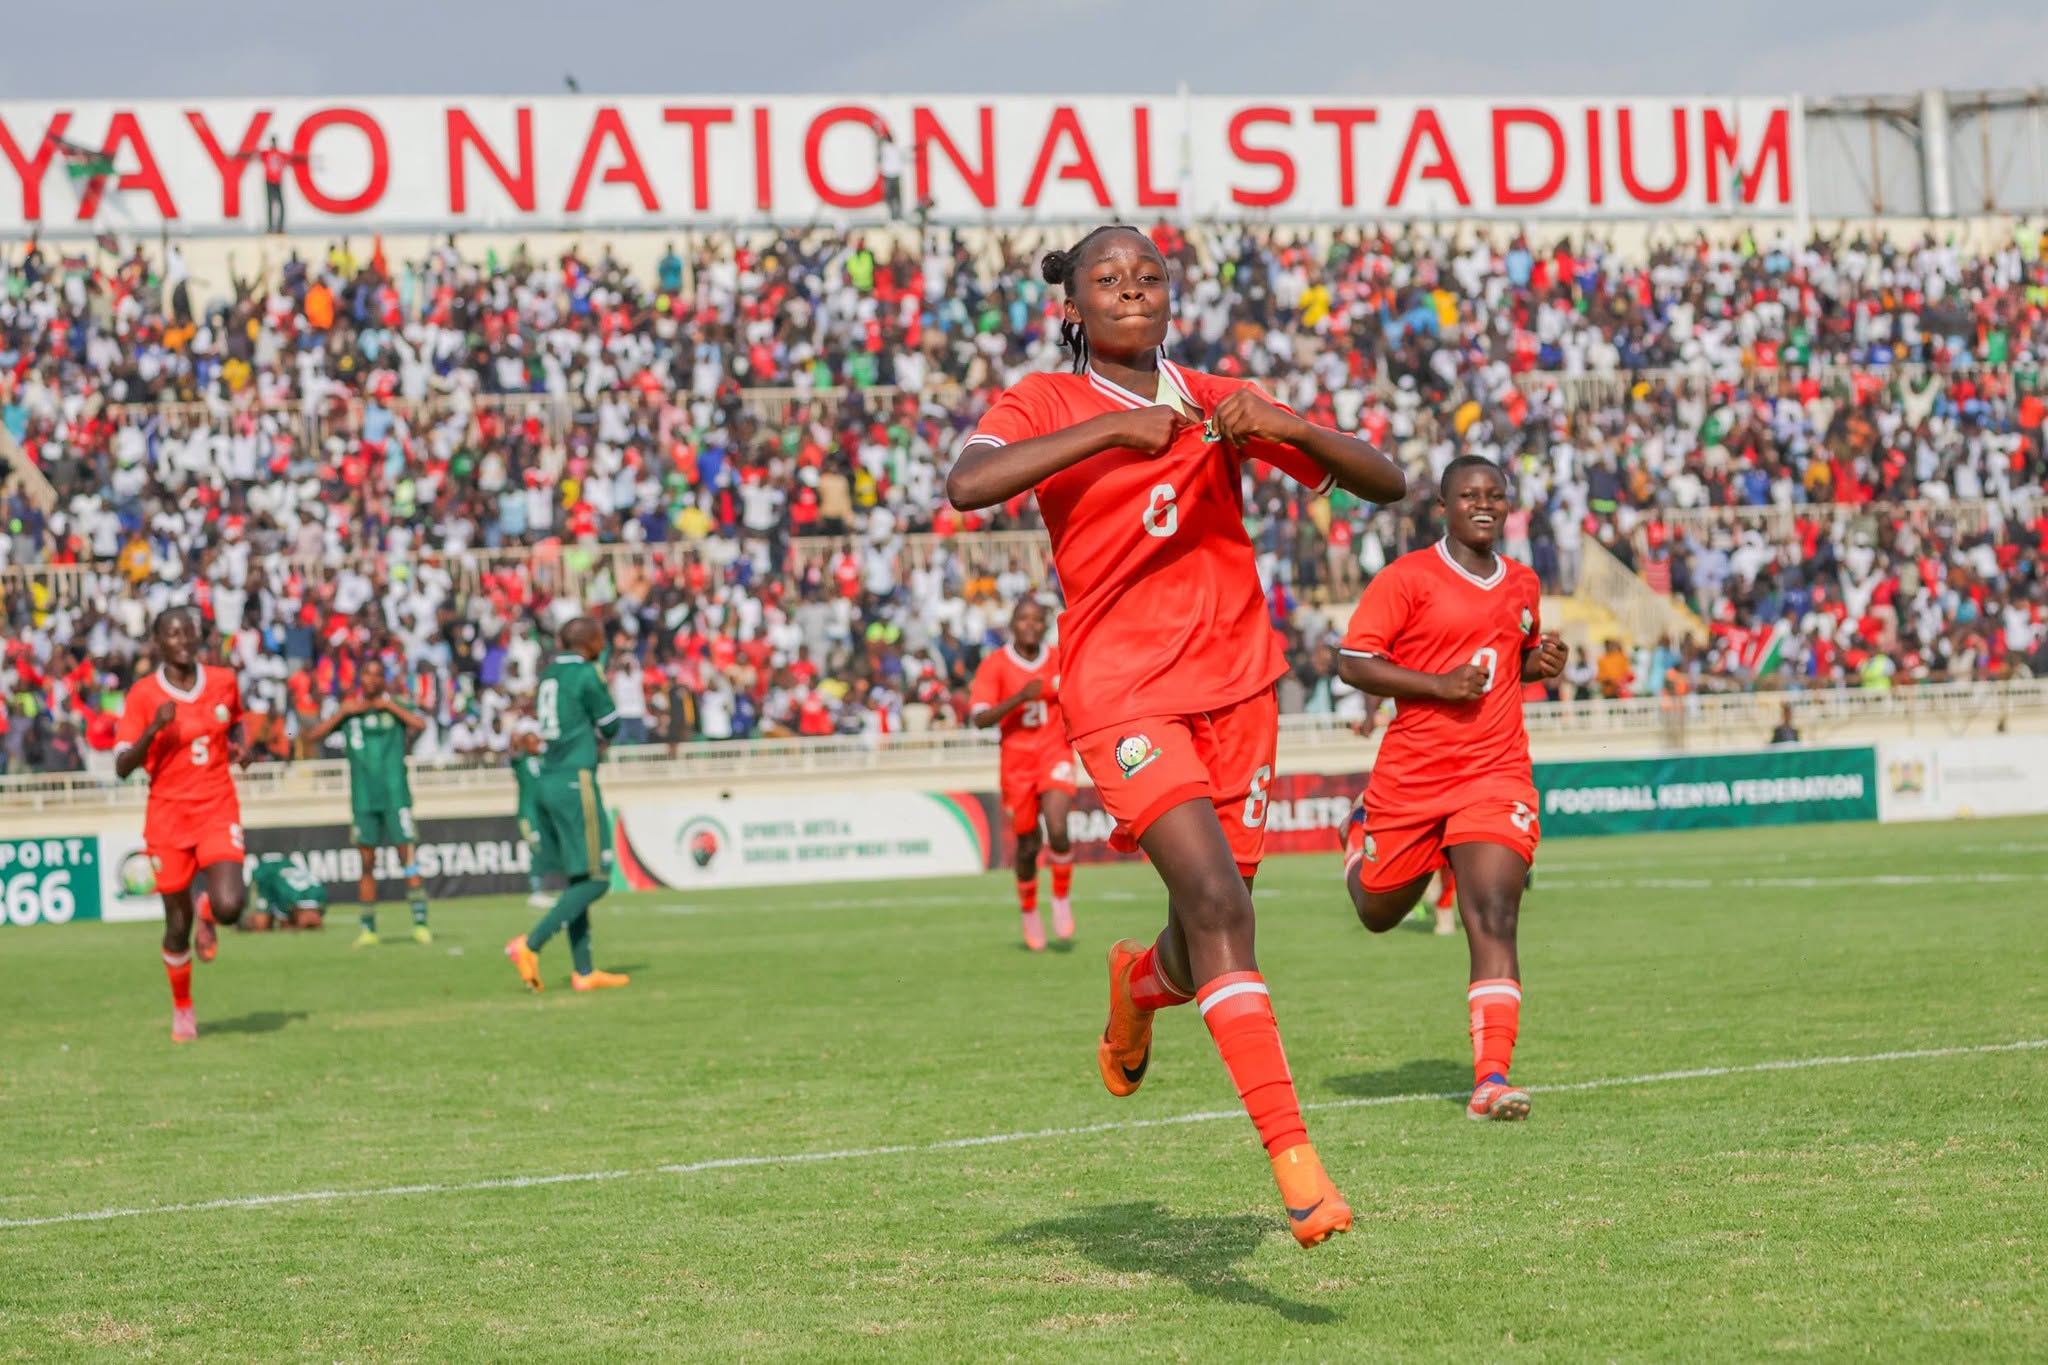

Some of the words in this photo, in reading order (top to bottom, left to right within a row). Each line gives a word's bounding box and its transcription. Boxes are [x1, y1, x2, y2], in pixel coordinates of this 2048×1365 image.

[0, 107, 391, 220] YAYO
[446, 105, 1180, 213] NATIONAL
[1227, 106, 1791, 208] STADIUM
[1143, 483, 1177, 537] 6
[1022, 700, 1048, 727] 21
[191, 735, 209, 765] 5
[1241, 764, 1272, 828] 6
[1545, 788, 1656, 815] FOOTBALL
[1658, 782, 1730, 808] KENYA
[1732, 774, 1864, 805] FEDERATION
[0, 838, 93, 871] PORT.
